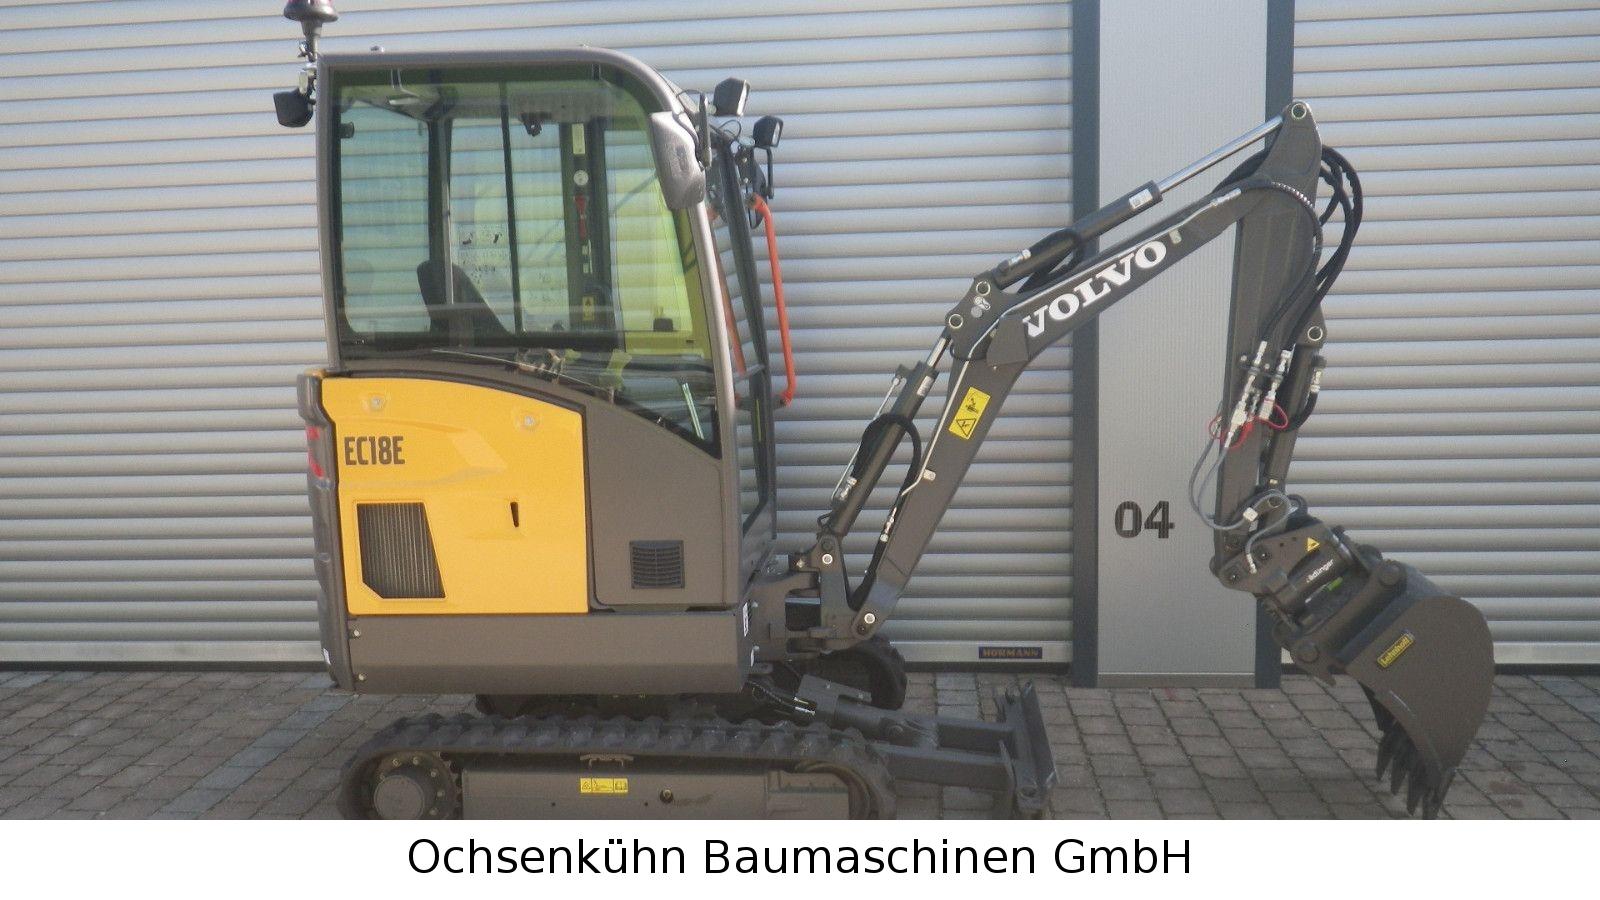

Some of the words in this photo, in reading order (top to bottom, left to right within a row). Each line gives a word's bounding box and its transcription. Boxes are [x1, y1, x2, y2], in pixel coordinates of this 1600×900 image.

[1022, 241, 1167, 338] VOLVO
[344, 435, 406, 466] EC18E
[1114, 500, 1176, 539] 04
